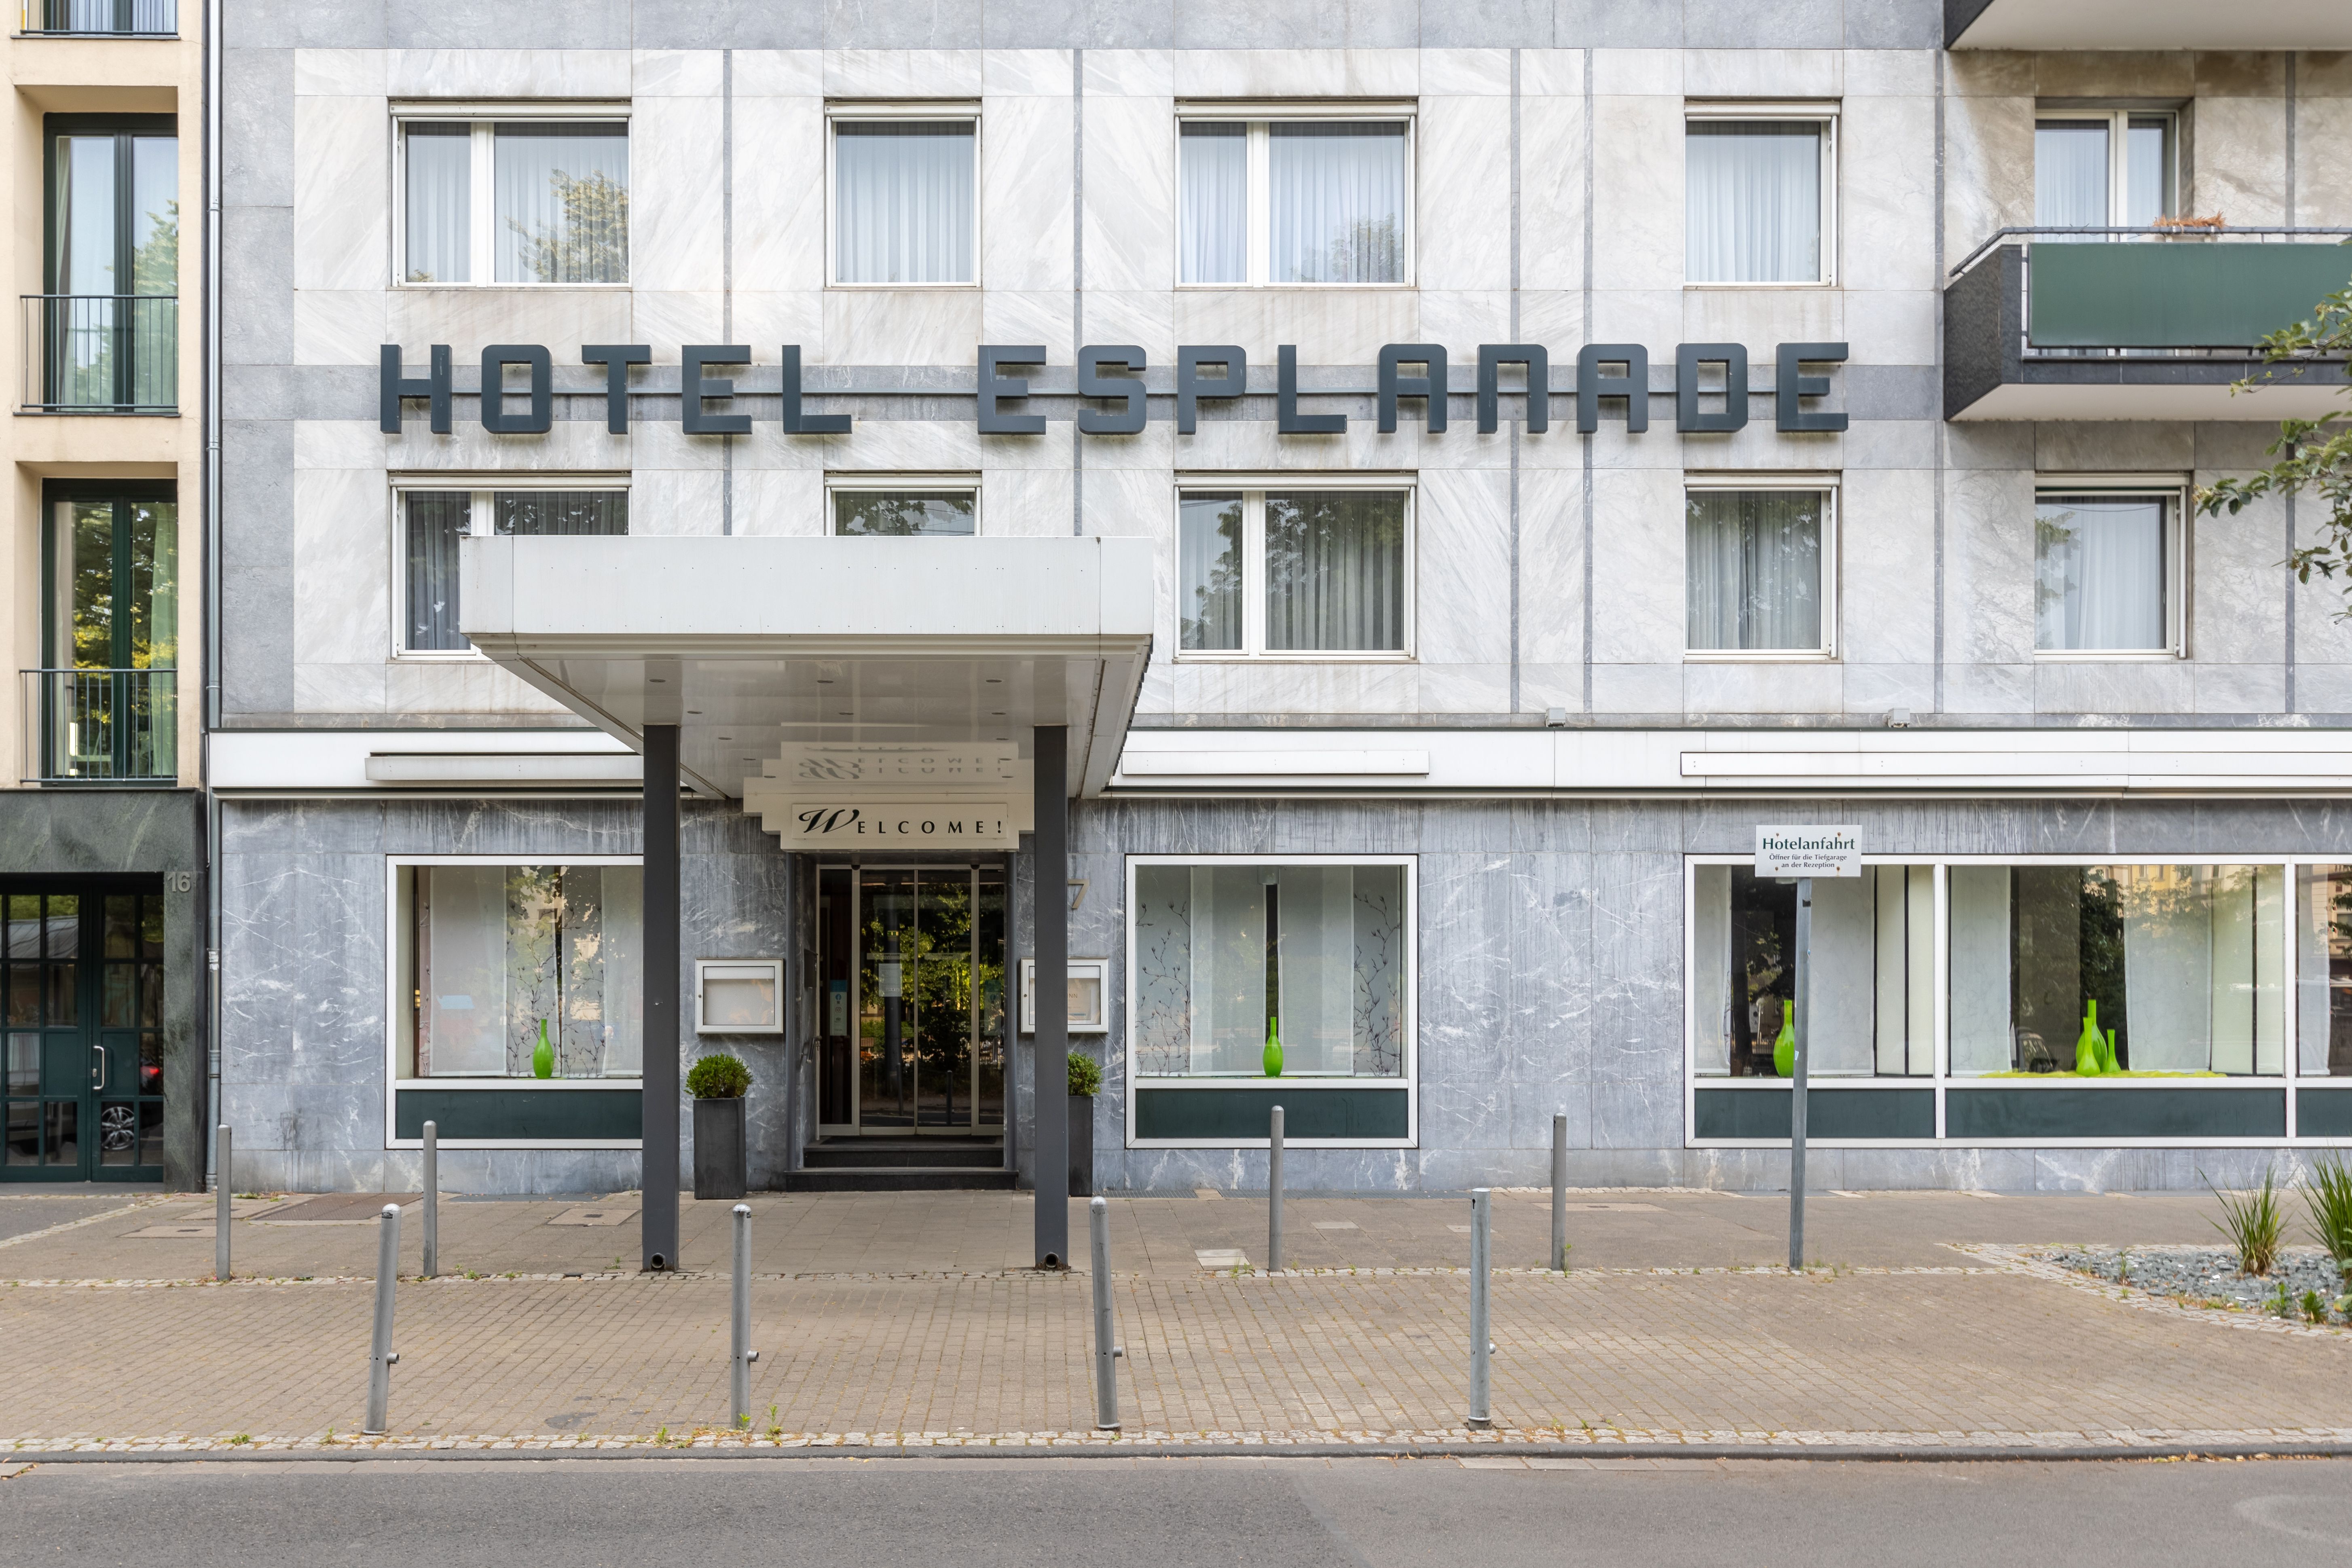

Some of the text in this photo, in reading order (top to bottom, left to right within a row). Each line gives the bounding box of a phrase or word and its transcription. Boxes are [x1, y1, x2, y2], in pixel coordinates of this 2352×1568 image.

[380, 343, 1849, 435] HOTEL ESPLANADE
[798, 809, 1002, 834] WELCOME!
[1763, 837, 1855, 850] Hotelanfahrt
[167, 872, 191, 893] 16
